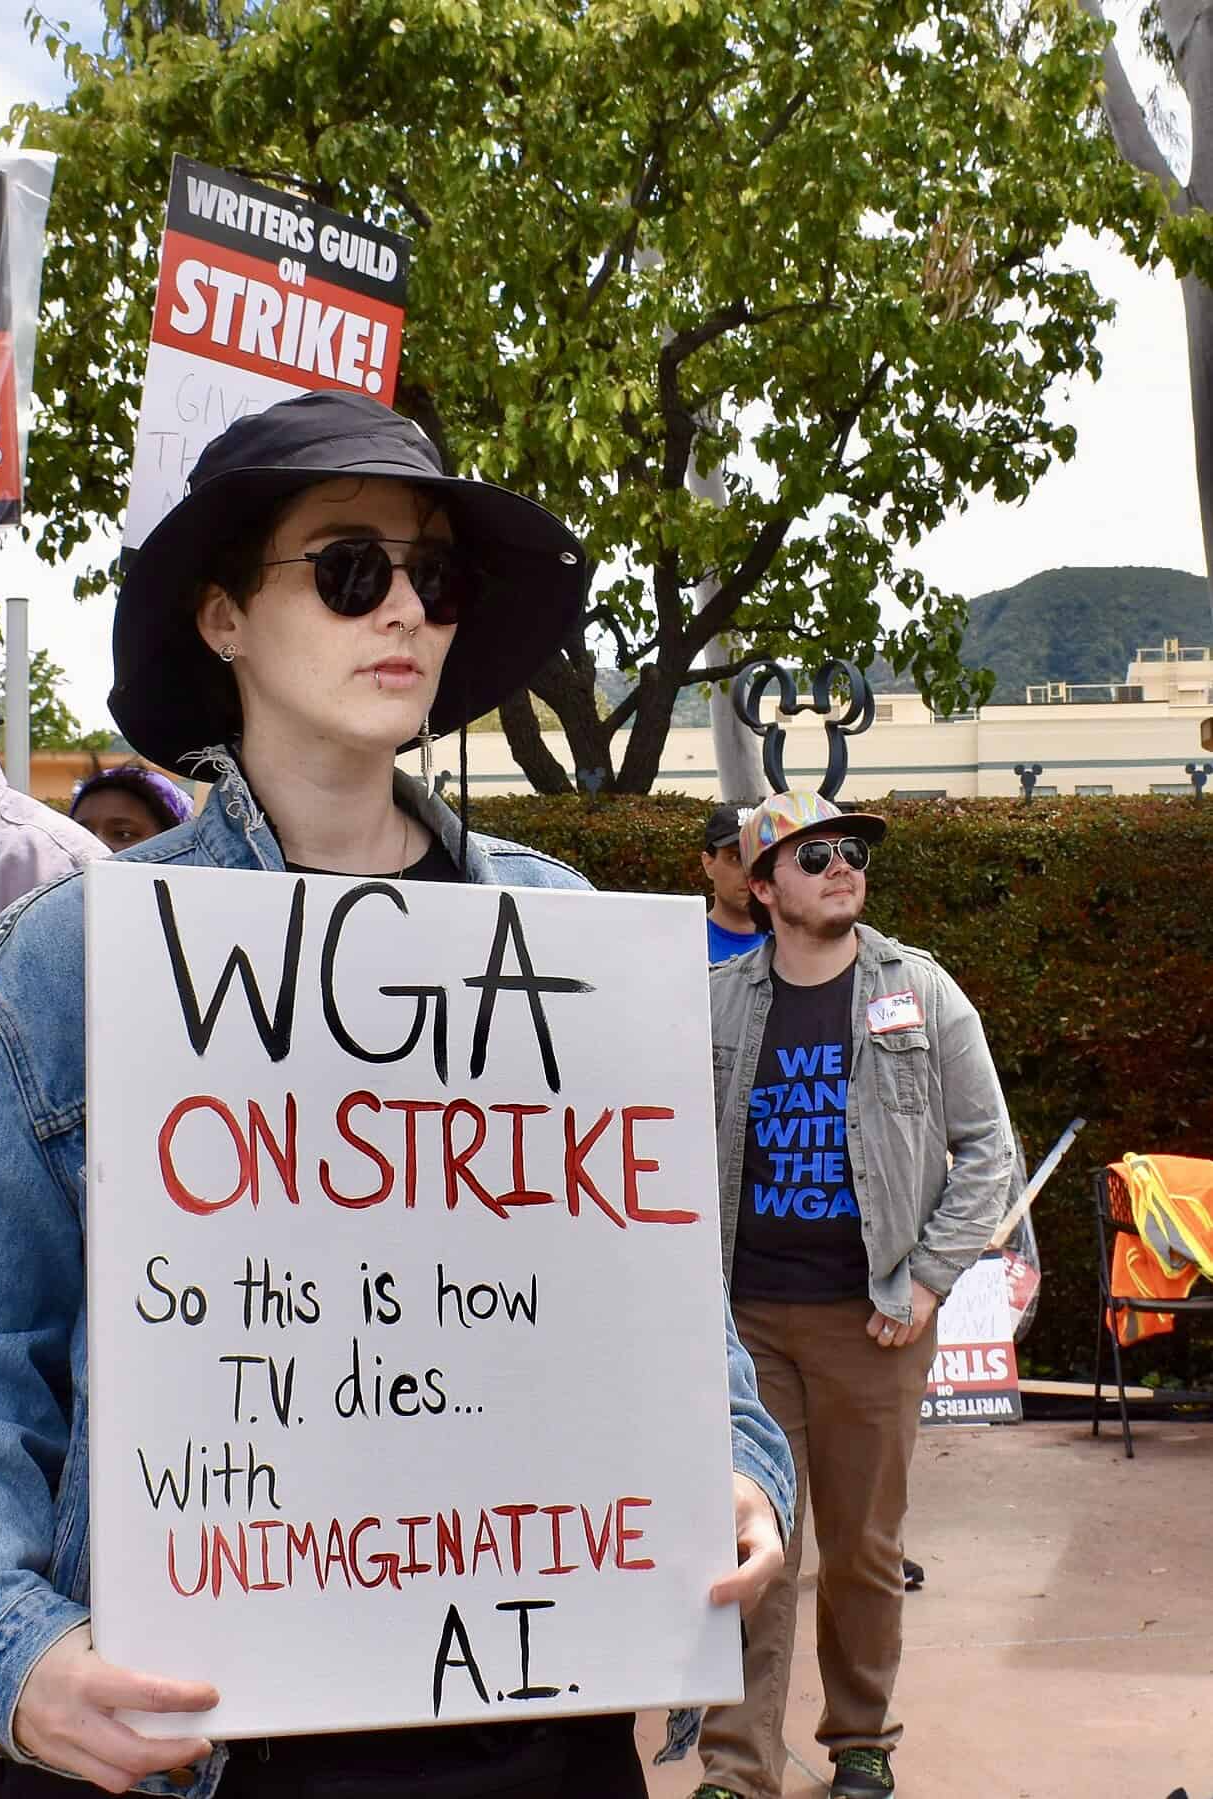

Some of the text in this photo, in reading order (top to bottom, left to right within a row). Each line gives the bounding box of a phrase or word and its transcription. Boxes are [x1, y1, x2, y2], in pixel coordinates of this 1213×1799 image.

[186, 176, 396, 283] WRITERS GUILD
[278, 257, 306, 287] ON
[170, 260, 388, 394] STRIKE!
[153, 877, 597, 1093] WGA
[776, 1045, 843, 1078] WE
[158, 1089, 701, 1229] ON STRIKE
[768, 1152, 844, 1183] THE
[754, 1183, 859, 1220] WGA
[136, 1255, 537, 1330] So this is how
[219, 1337, 483, 1427] T.V. dies...
[936, 1384, 954, 1397] ON
[936, 1397, 1014, 1418] WRITERS
[137, 1437, 281, 1512] With
[168, 1497, 655, 1599] UNIMAGINATIVE
[432, 1599, 579, 1717] A.I.
